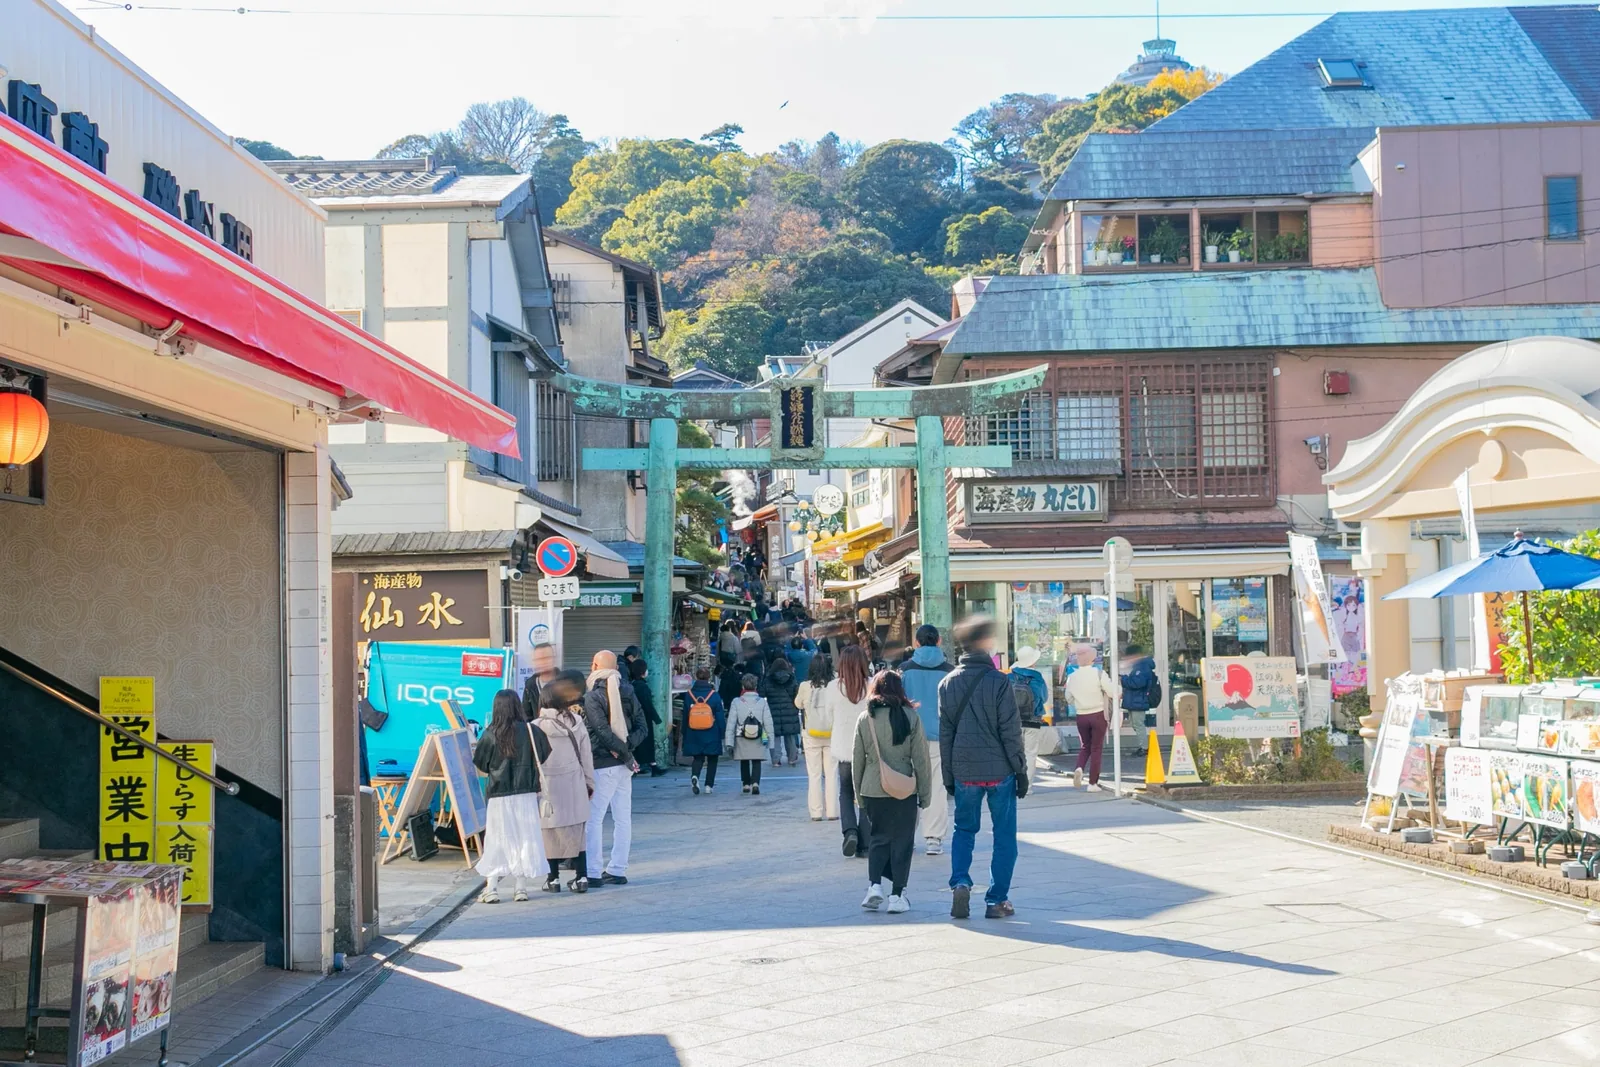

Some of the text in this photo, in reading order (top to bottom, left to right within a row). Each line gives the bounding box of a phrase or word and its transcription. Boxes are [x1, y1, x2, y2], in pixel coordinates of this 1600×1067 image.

[975, 484, 1096, 512] 海産物 丸だい
[374, 573, 423, 590] 海産物
[543, 582, 575, 596] ここまで
[397, 683, 475, 707] IQOS
